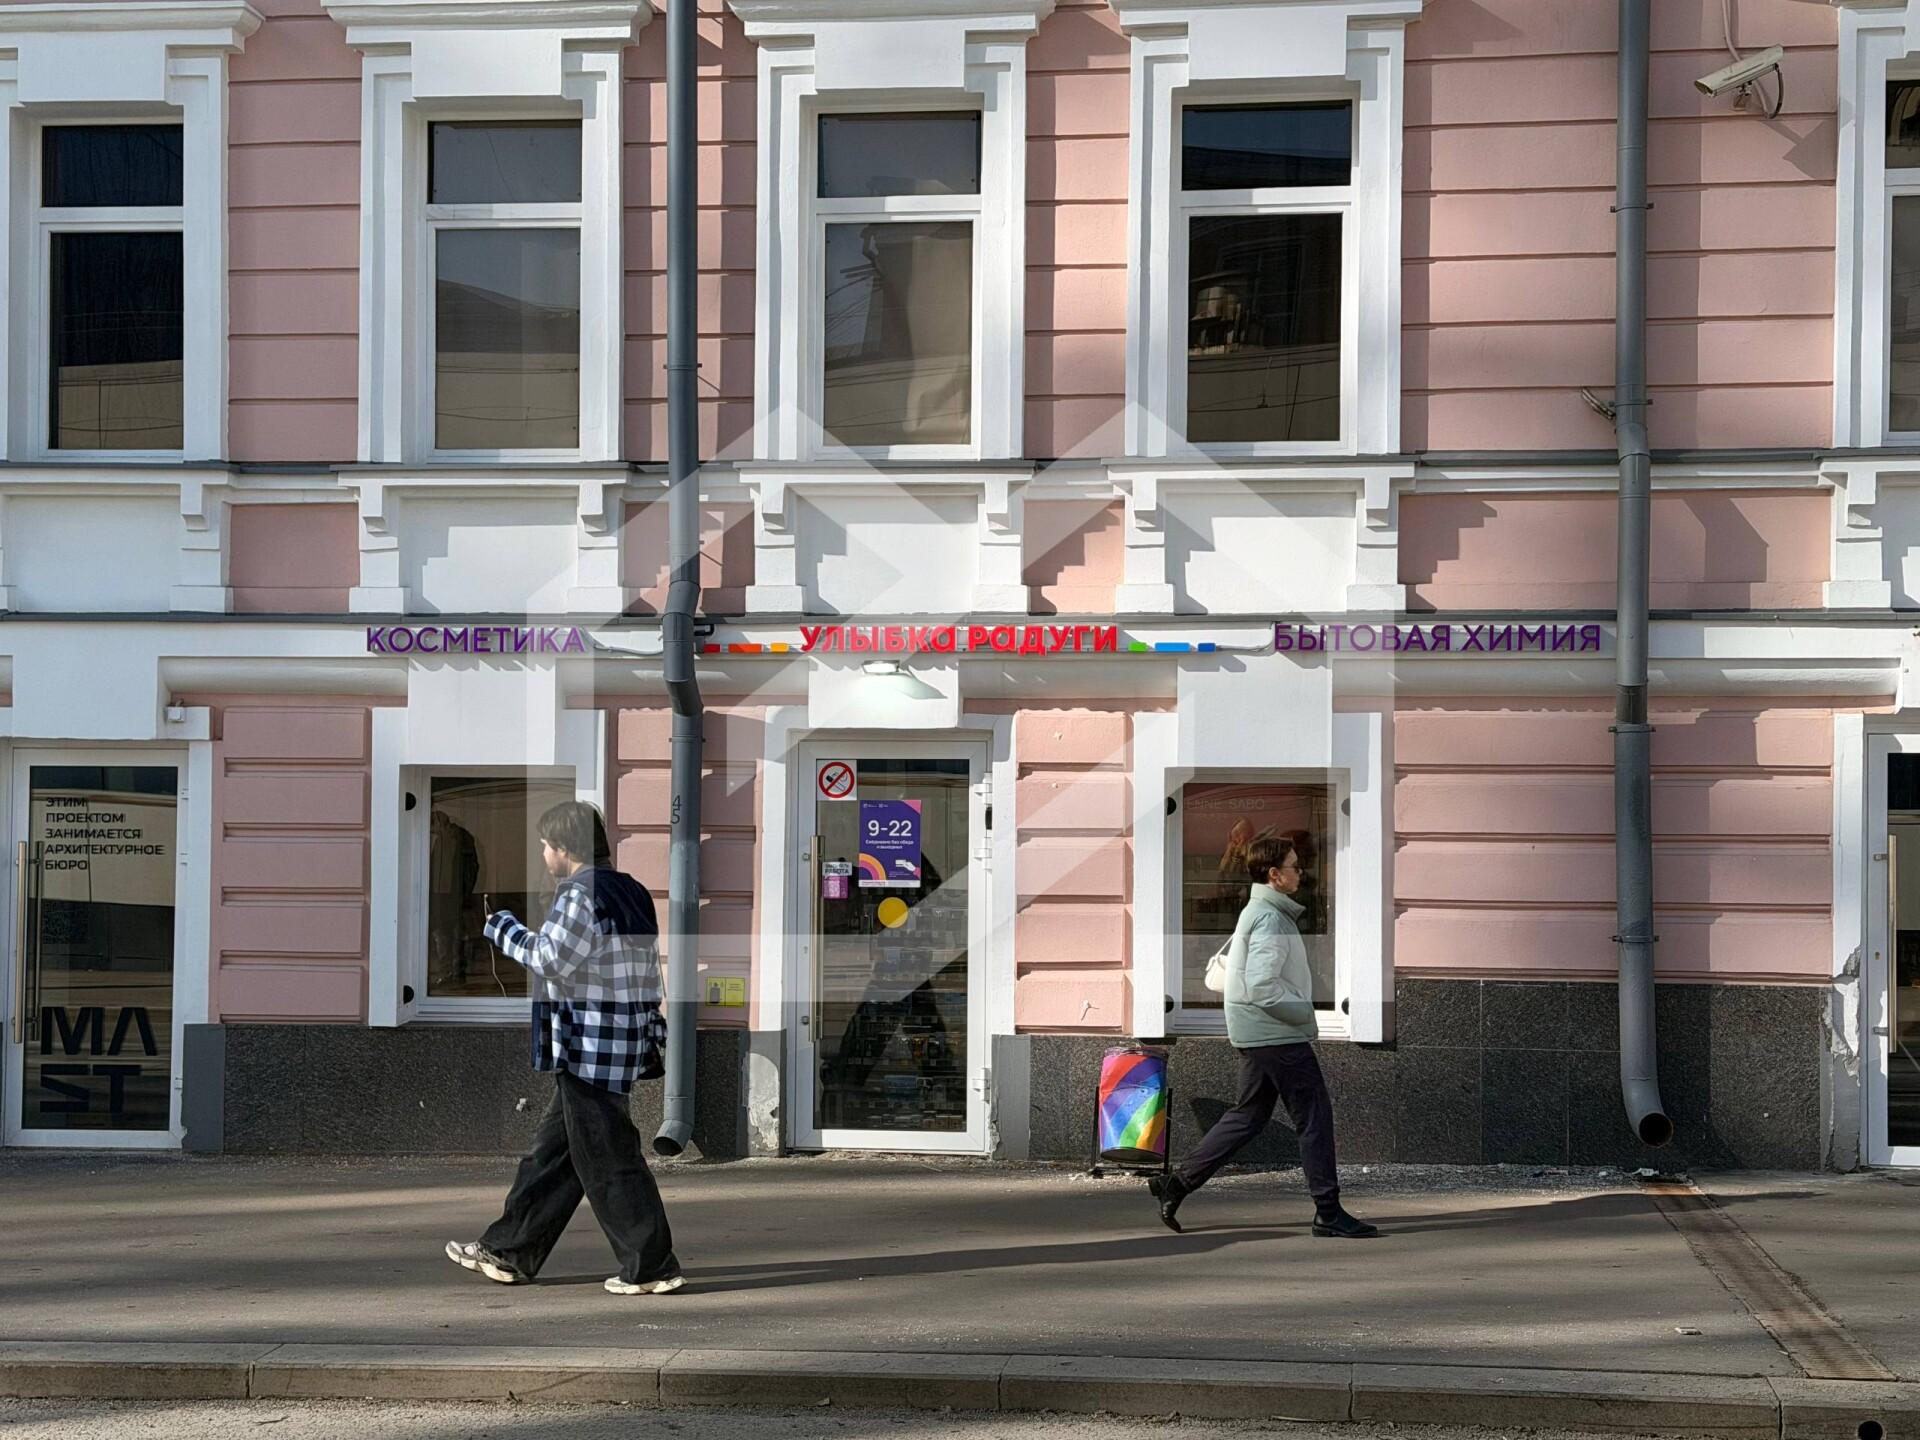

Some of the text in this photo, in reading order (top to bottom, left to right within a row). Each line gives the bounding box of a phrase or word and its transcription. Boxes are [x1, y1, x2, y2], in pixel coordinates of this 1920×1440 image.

[366, 627, 585, 653] КОСМЕТИКА
[1274, 624, 1601, 651] БЫТОВАЯ ХИМИЯ
[46, 797, 86, 808] ЭТИМ
[46, 813, 126, 824] ПРОЕКТОМ
[45, 828, 143, 840] ЗАНИМАЕТСЯ
[867, 819, 912, 837] 9-22
[45, 844, 166, 856] АРХИТЕКТУРНОЕ
[45, 859, 88, 871] БЮРО
